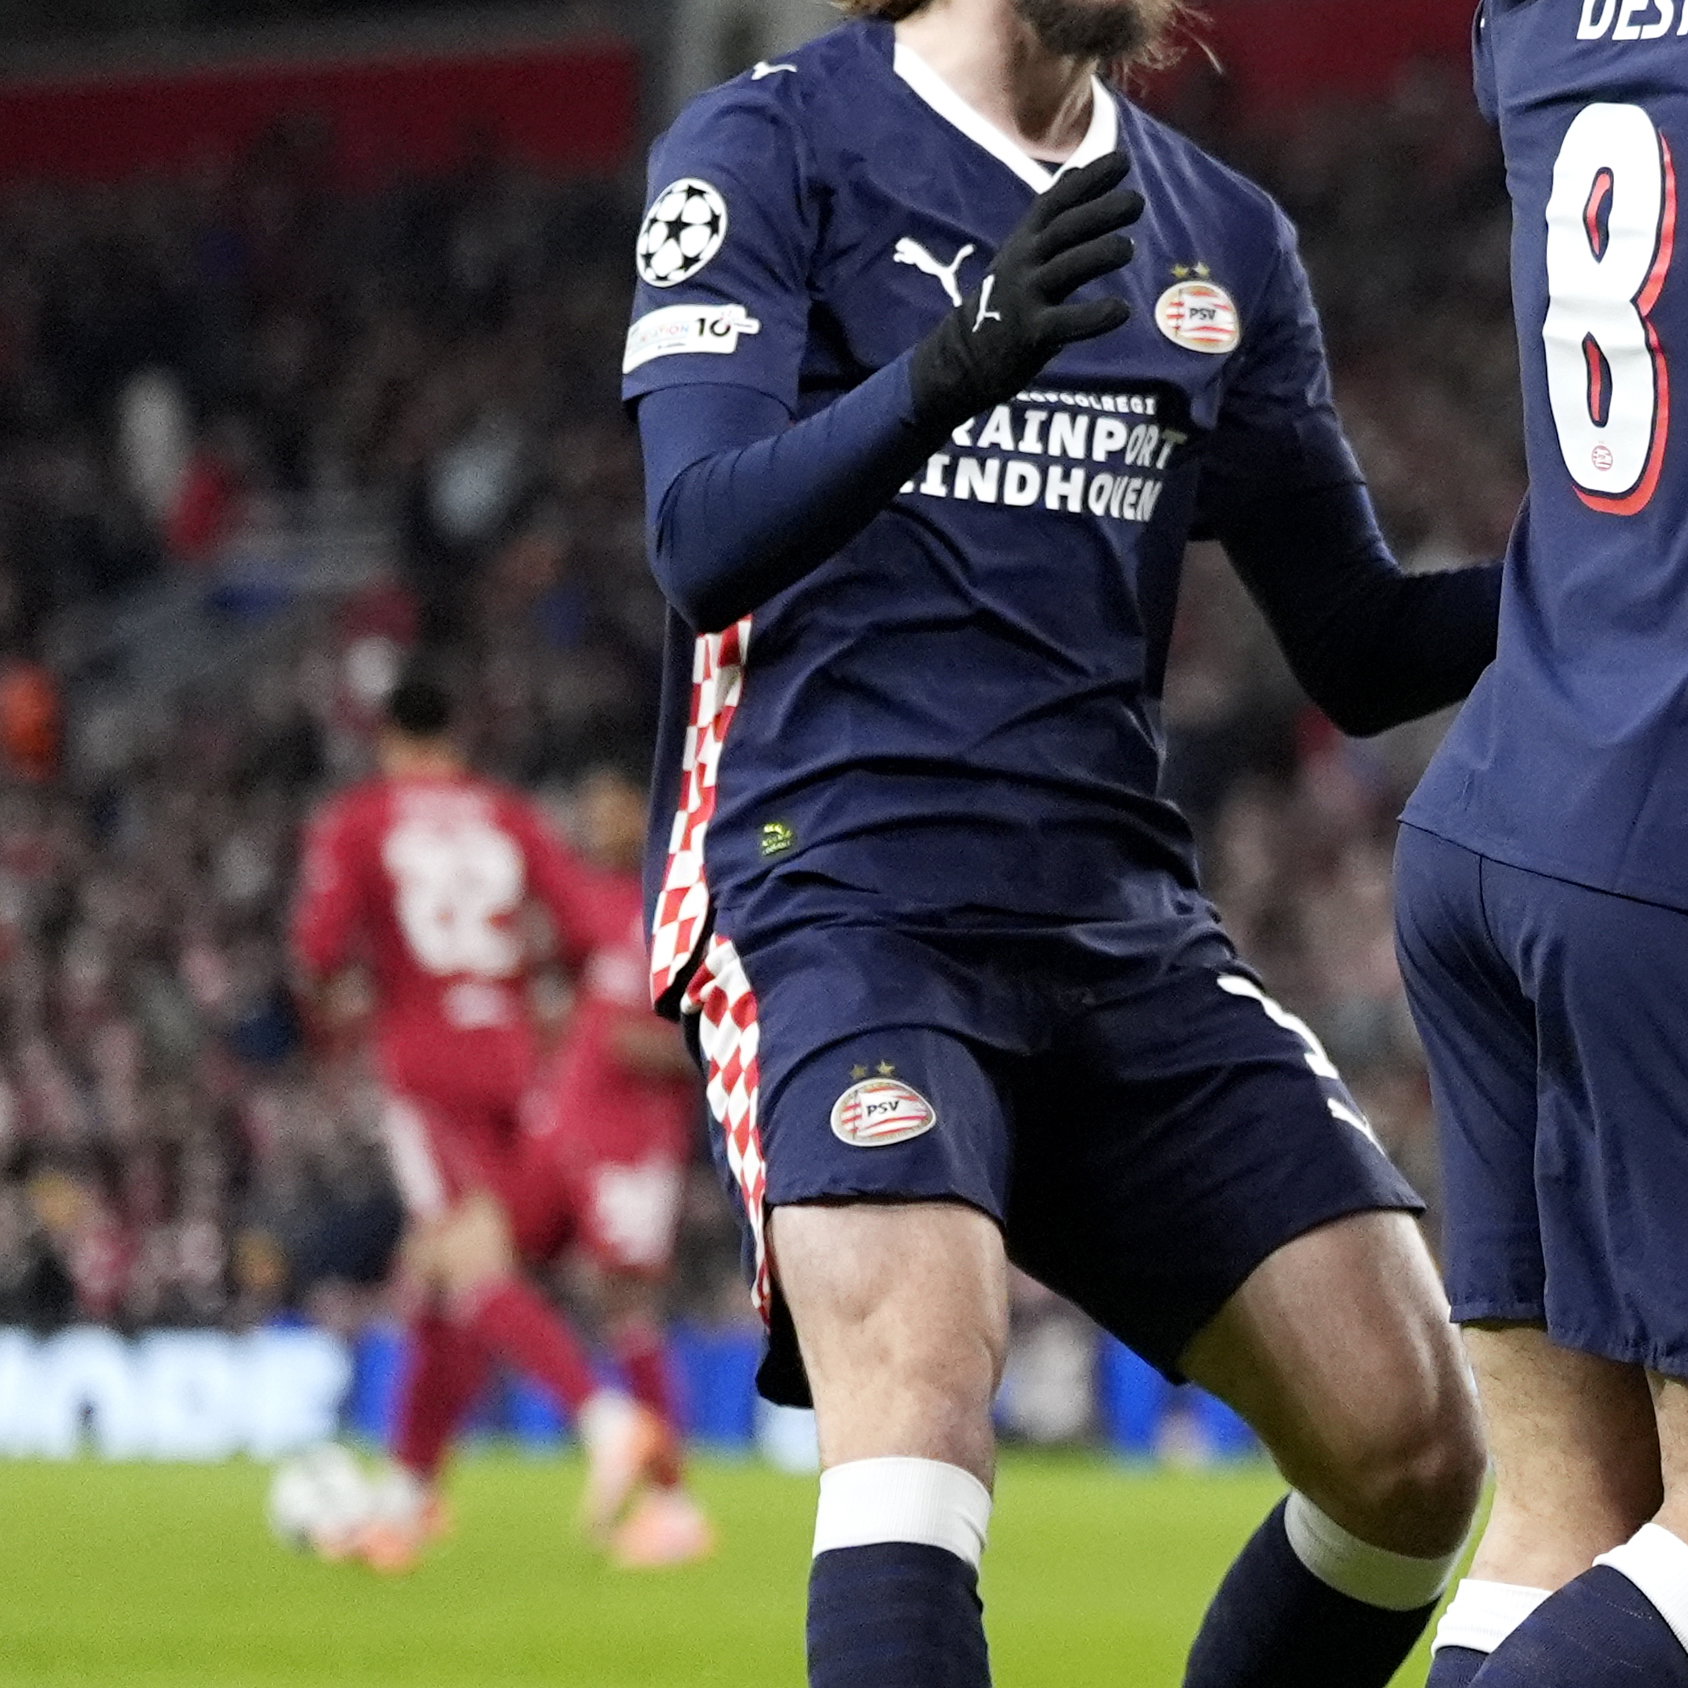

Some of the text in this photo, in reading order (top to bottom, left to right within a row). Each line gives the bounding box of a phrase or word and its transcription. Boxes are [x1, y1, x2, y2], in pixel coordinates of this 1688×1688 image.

[1189, 307, 1217, 321] PSV
[1542, 101, 1678, 516] 8
[866, 1100, 900, 1117] PSV
